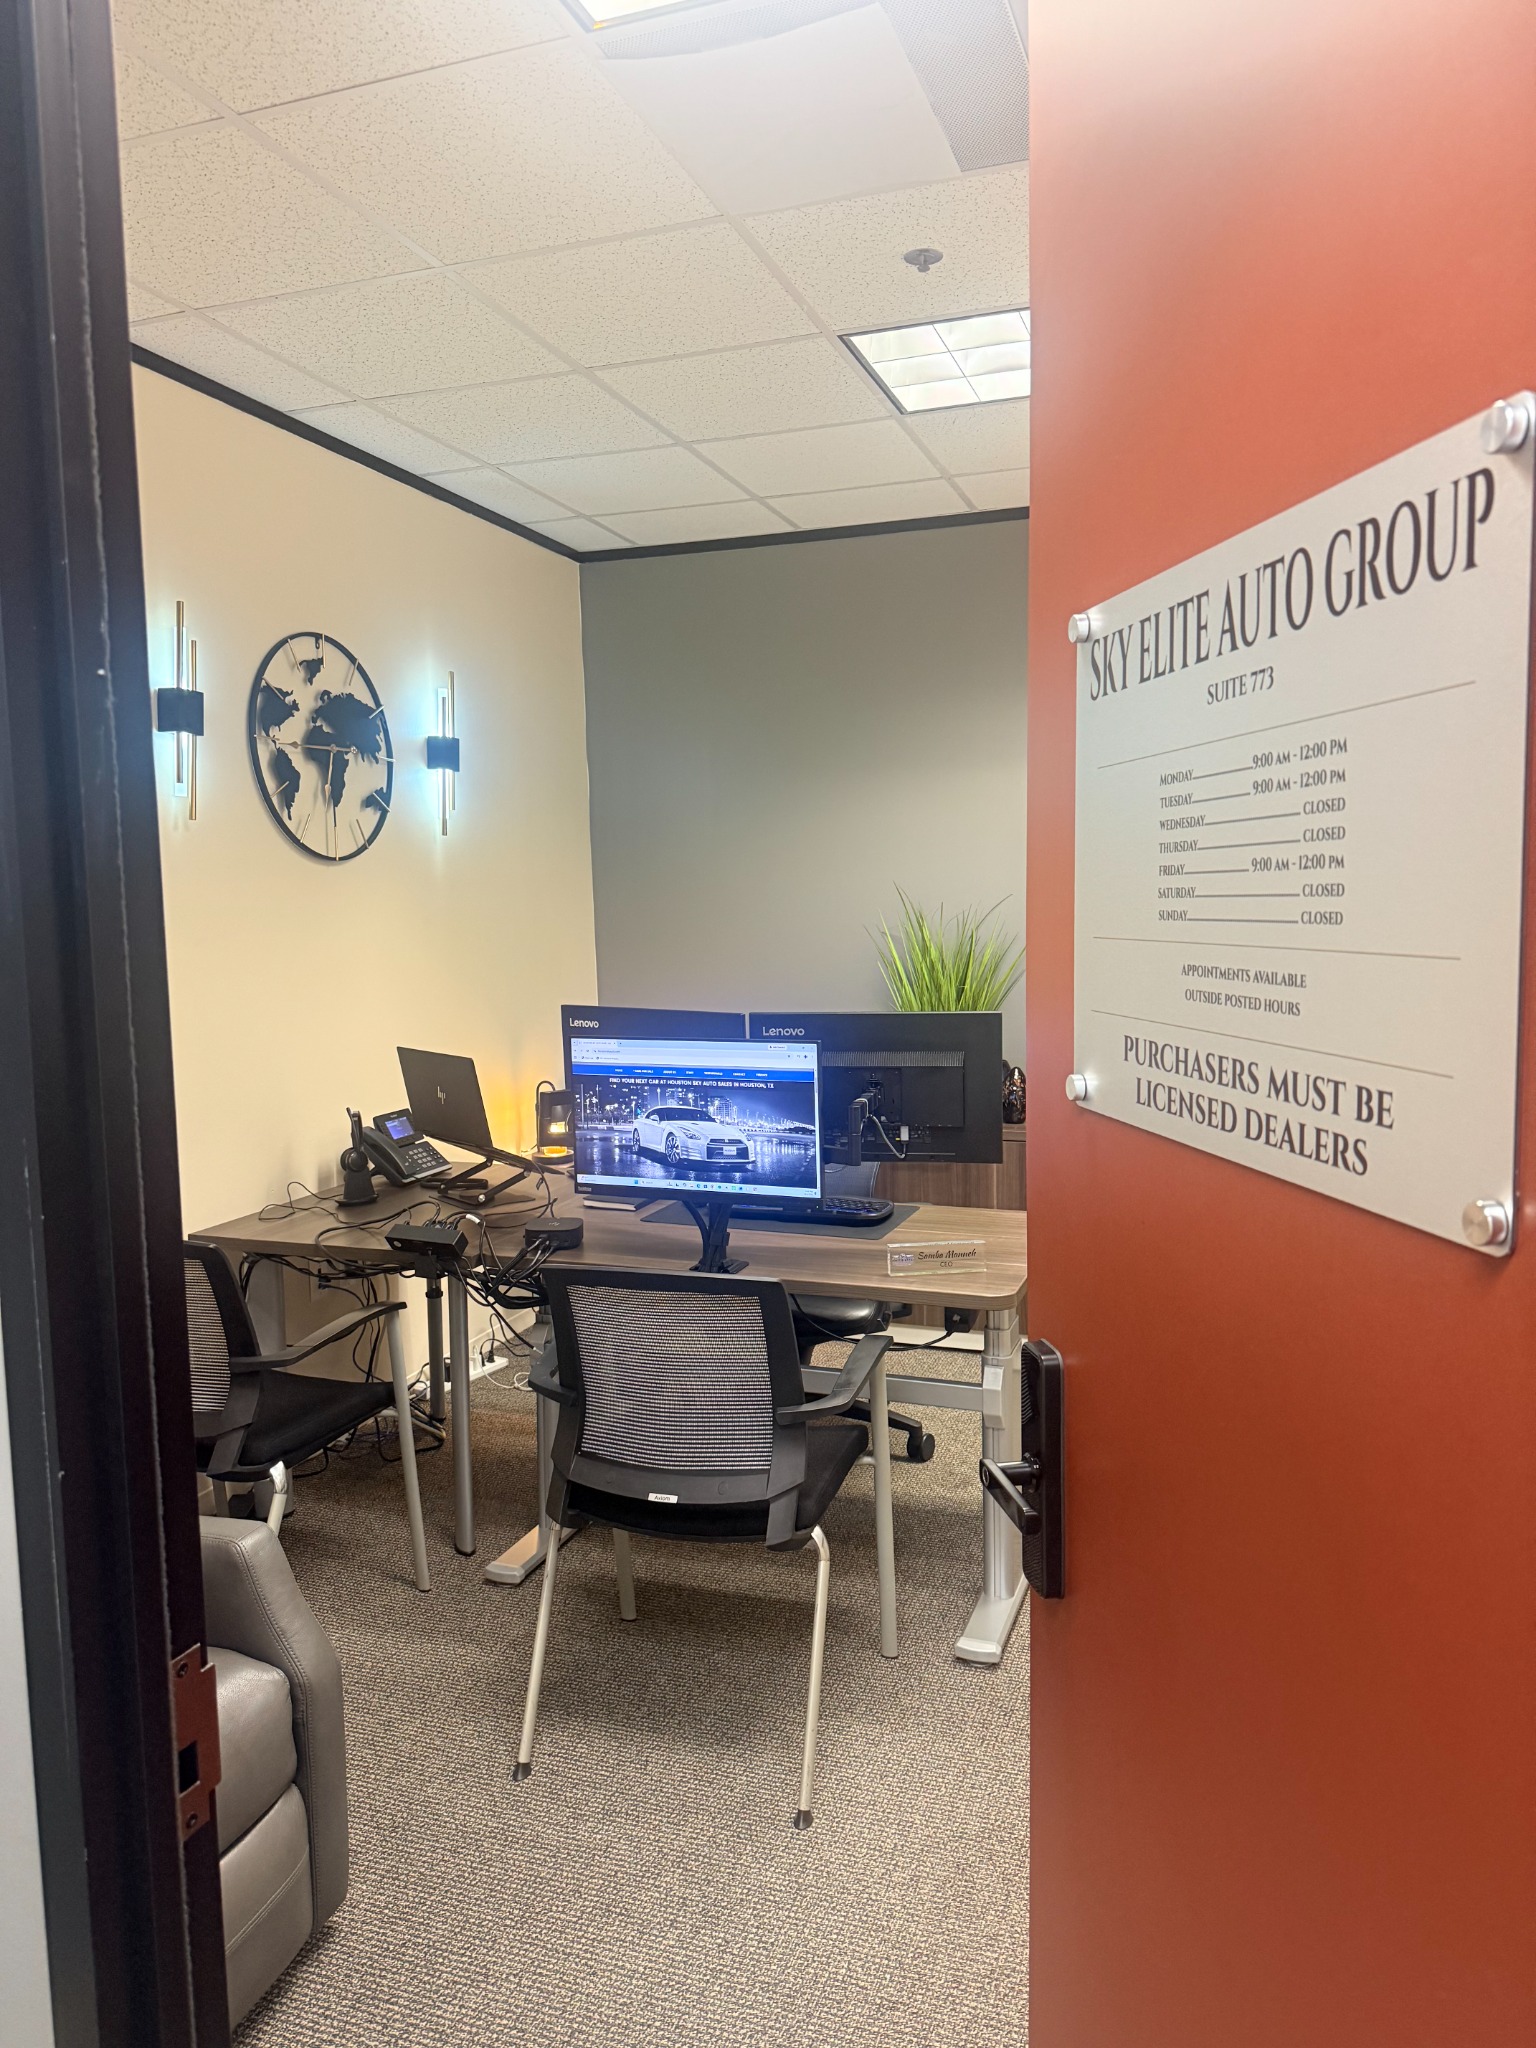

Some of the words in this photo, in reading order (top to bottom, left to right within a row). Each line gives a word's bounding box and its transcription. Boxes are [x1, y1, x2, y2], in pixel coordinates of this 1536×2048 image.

[1090, 624, 1133, 701] SKY
[1138, 589, 1210, 685] ELITE
[1216, 546, 1314, 657] AUTO
[1325, 467, 1495, 617] GROUP
[1207, 671, 1248, 705] SUITE
[1250, 665, 1275, 692] 773
[1159, 769, 1194, 786] MONDAY
[1252, 752, 1273, 769] 9:00
[1275, 751, 1291, 765] AM
[1299, 741, 1327, 761] 12:00
[1329, 737, 1348, 756] PM
[1160, 793, 1193, 809] TUESDAY
[1252, 778, 1273, 795] 9:00
[1275, 778, 1291, 792] AM
[1299, 769, 1327, 788] 12:00
[1329, 768, 1346, 783] PM
[1159, 815, 1206, 831] WEDNESDAY
[1303, 797, 1346, 815] CLOSED
[1159, 839, 1199, 854] THURSDAY
[1303, 826, 1346, 843] CLOSED
[1158, 864, 1186, 876] FRIDAY
[1251, 857, 1272, 872] 9:00
[1274, 857, 1290, 871] AM
[1298, 853, 1326, 870] 12:00
[1328, 855, 1345, 869] PM
[1157, 886, 1196, 899] SATURDAY
[1302, 883, 1345, 898] CLOSED
[1158, 910, 1188, 921] SUNDAY
[1301, 911, 1344, 925] CLOSED
[1181, 964, 1251, 983] APPOINTMENTS
[1252, 970, 1307, 989] AVAILABLE
[1185, 988, 1223, 1005] OUTSIDE
[1224, 993, 1262, 1011] POSTED
[1263, 999, 1301, 1017] HOURS
[569, 1017, 599, 1029] Lenovo
[762, 1026, 805, 1036] Lenovo
[1123, 1035, 1260, 1095] PURCHASERS
[1266, 1065, 1347, 1117] MUST
[1354, 1084, 1395, 1130] BE
[1135, 1077, 1238, 1134] LICENSED
[1244, 1107, 1369, 1176] DEALERS
